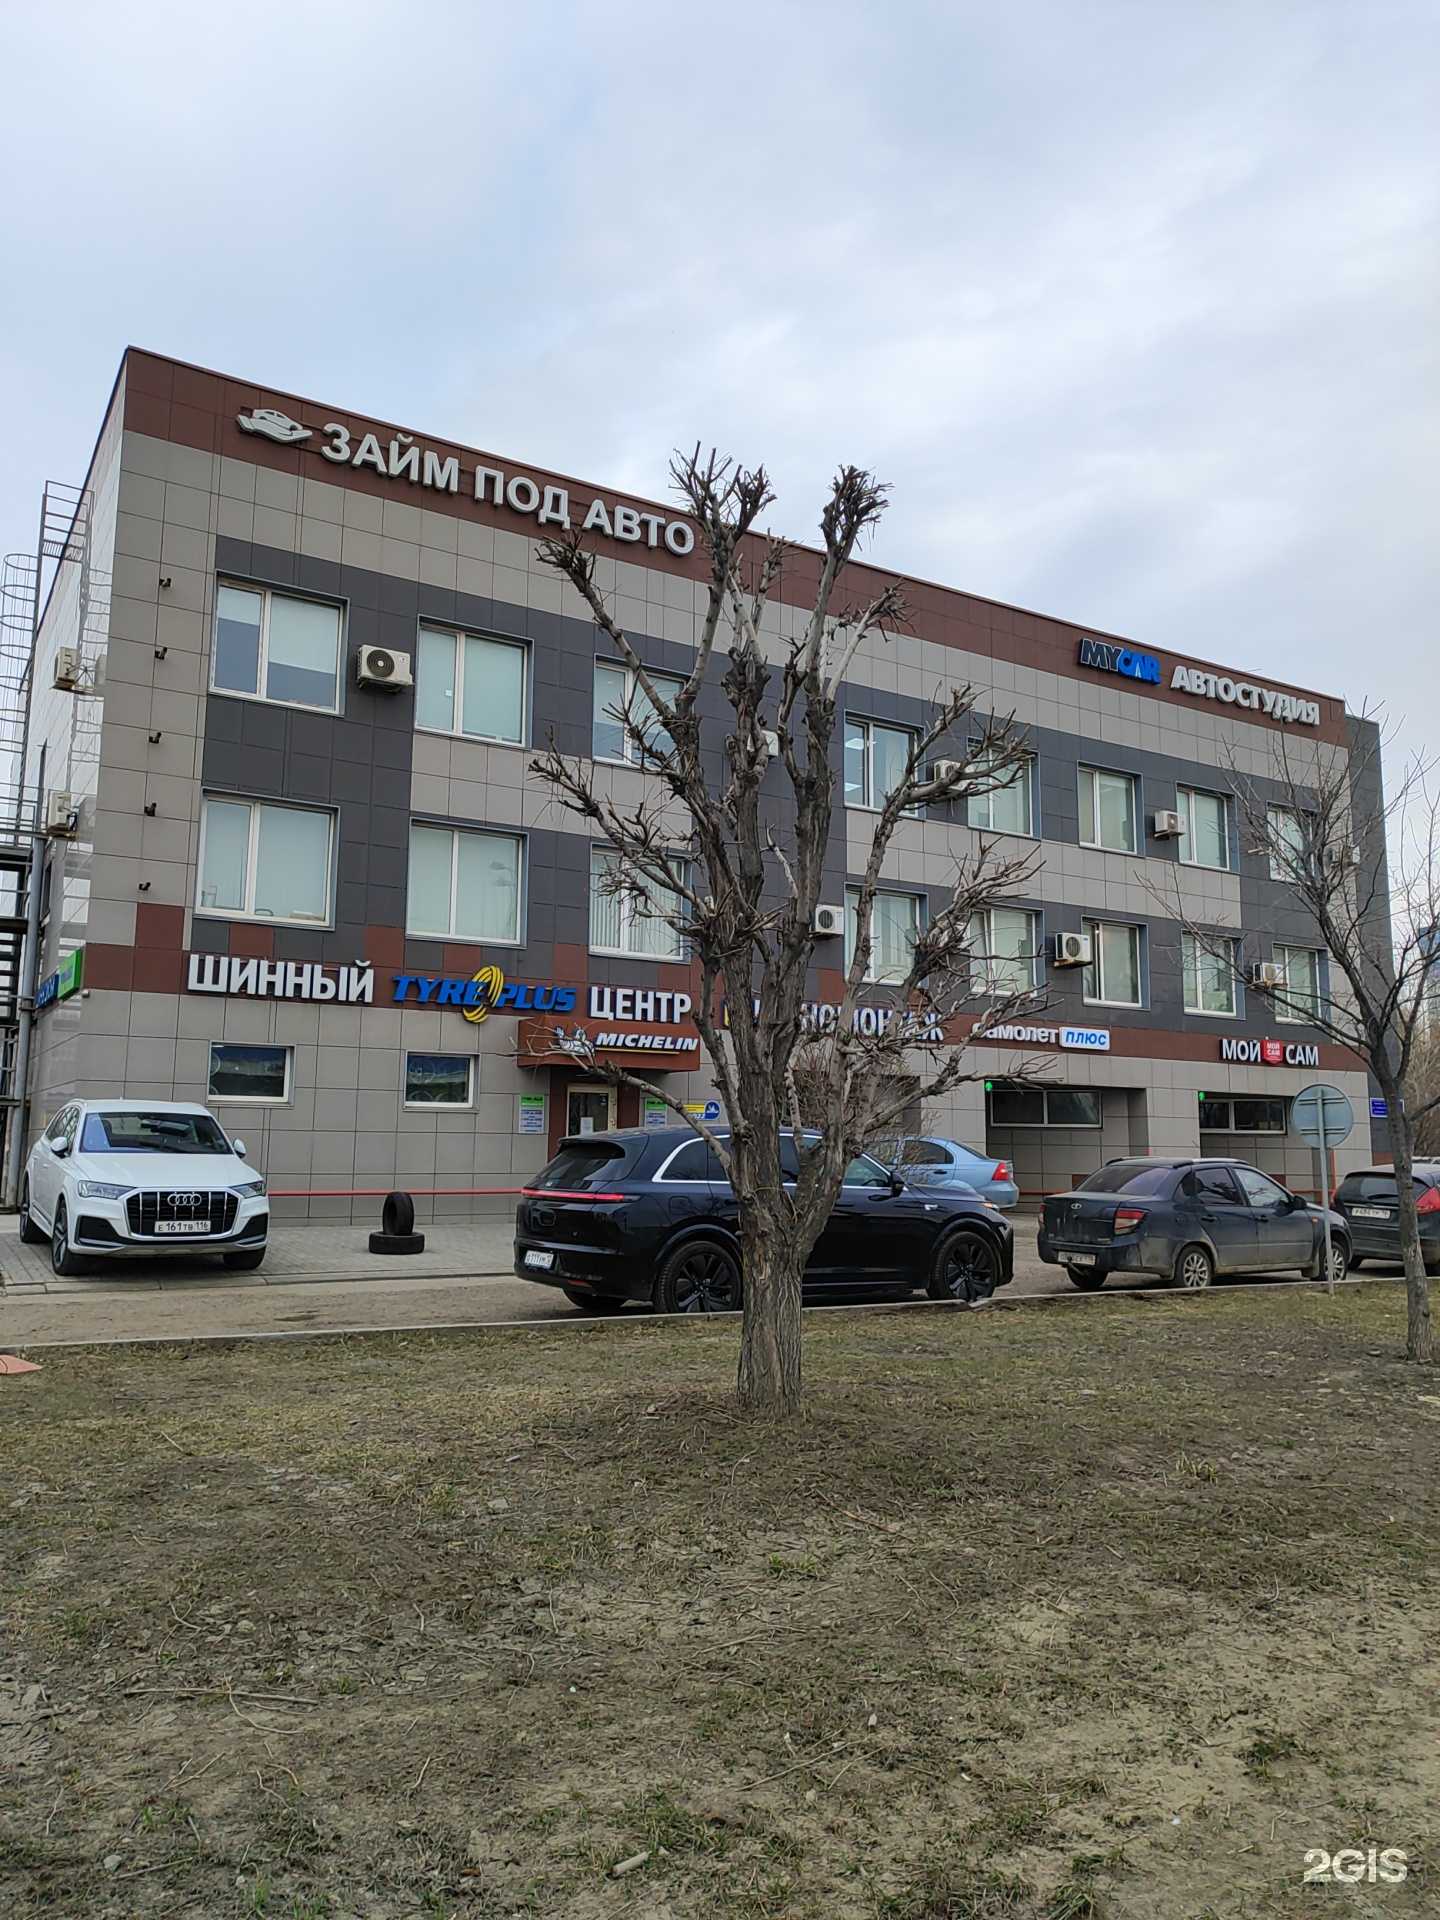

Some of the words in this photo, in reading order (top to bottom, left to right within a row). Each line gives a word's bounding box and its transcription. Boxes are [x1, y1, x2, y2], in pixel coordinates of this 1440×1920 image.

[320, 422, 459, 494] ЗАЙМ
[474, 465, 571, 530] ПОД
[581, 499, 696, 557] АВТО
[1170, 665, 1320, 726] АВТОСТУДИЯ
[187, 954, 375, 1003] ШИННЫЙ
[589, 985, 692, 1023] ЦЕНТР
[595, 1032, 699, 1051] MICHELIN
[1222, 1038, 1261, 1063] МОЙ
[1285, 1044, 1319, 1066] САМ
